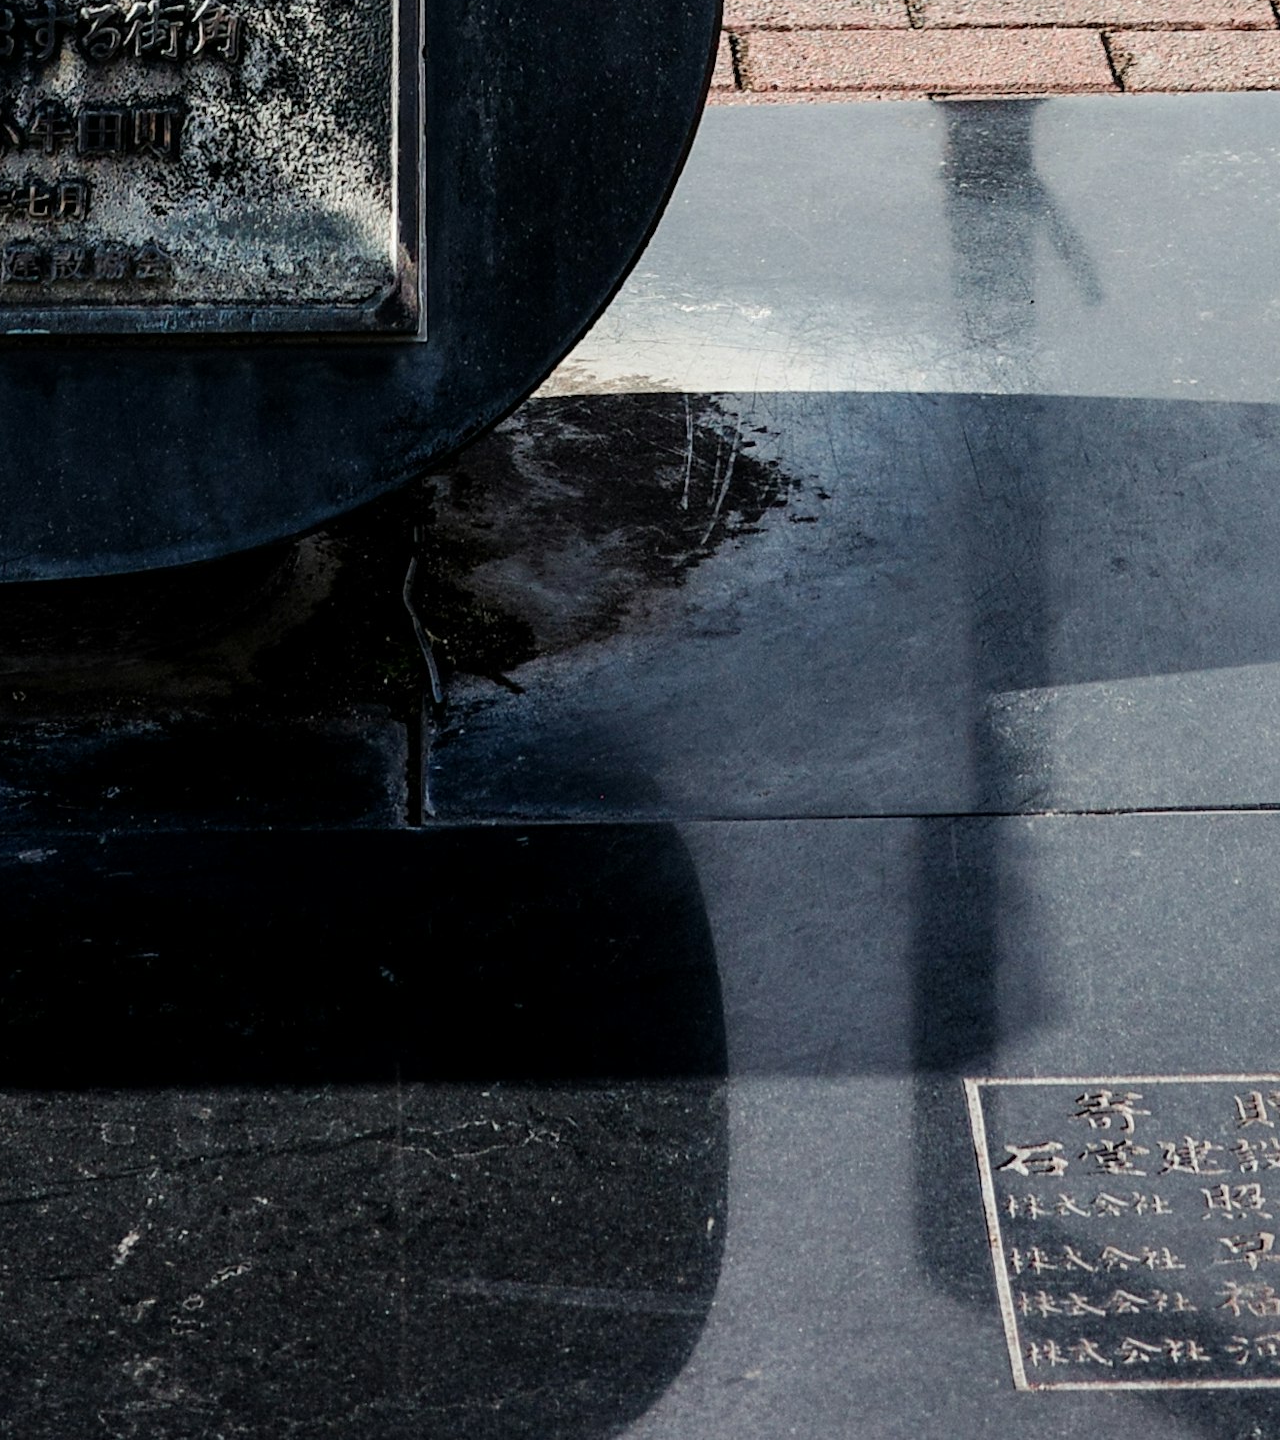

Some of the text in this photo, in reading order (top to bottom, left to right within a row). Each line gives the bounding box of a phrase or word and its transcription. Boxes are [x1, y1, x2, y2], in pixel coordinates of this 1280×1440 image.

[1005, 1190, 1173, 1221] 株式会社
[1009, 1244, 1187, 1274] 株式会社
[1017, 1288, 1199, 1318] 株式会社
[1025, 1336, 1212, 1367] 株式会社
